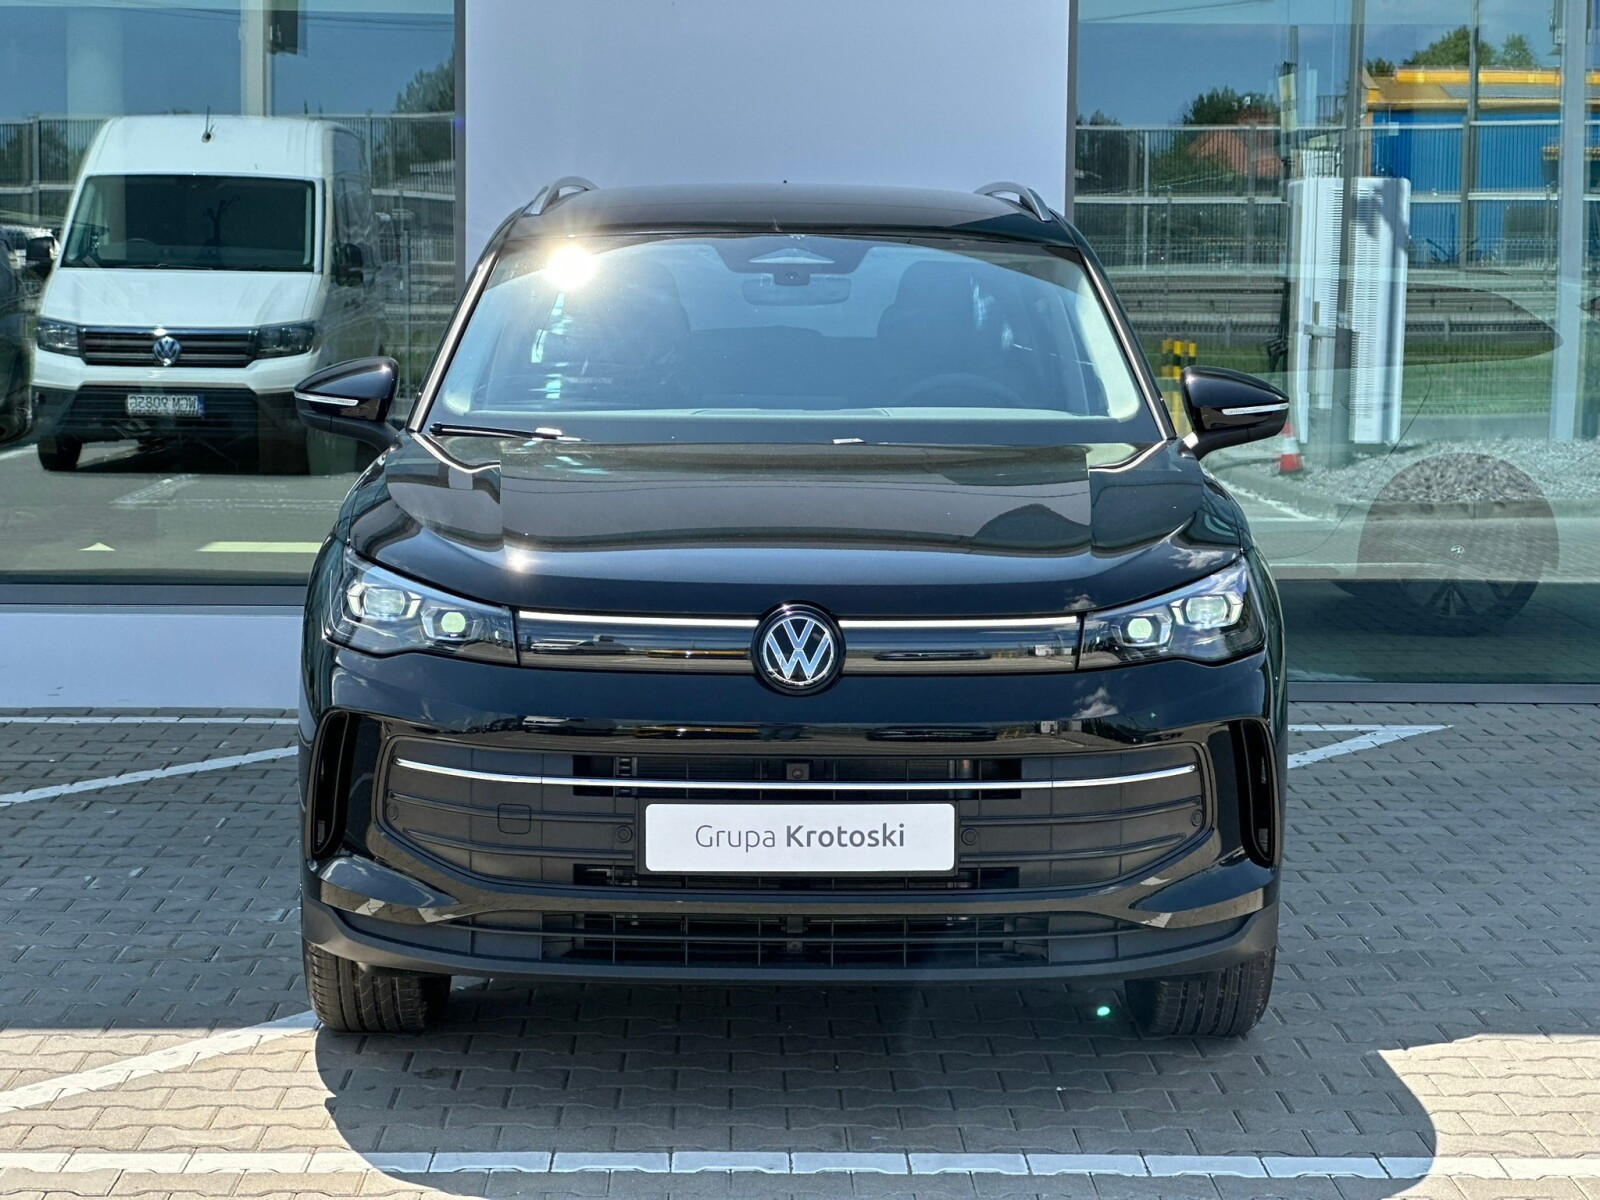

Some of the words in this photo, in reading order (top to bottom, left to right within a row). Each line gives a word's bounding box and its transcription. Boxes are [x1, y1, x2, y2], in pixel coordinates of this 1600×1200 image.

[763, 616, 834, 685] VW
[695, 825, 775, 852] Grupa
[786, 823, 905, 847] Krotoski
